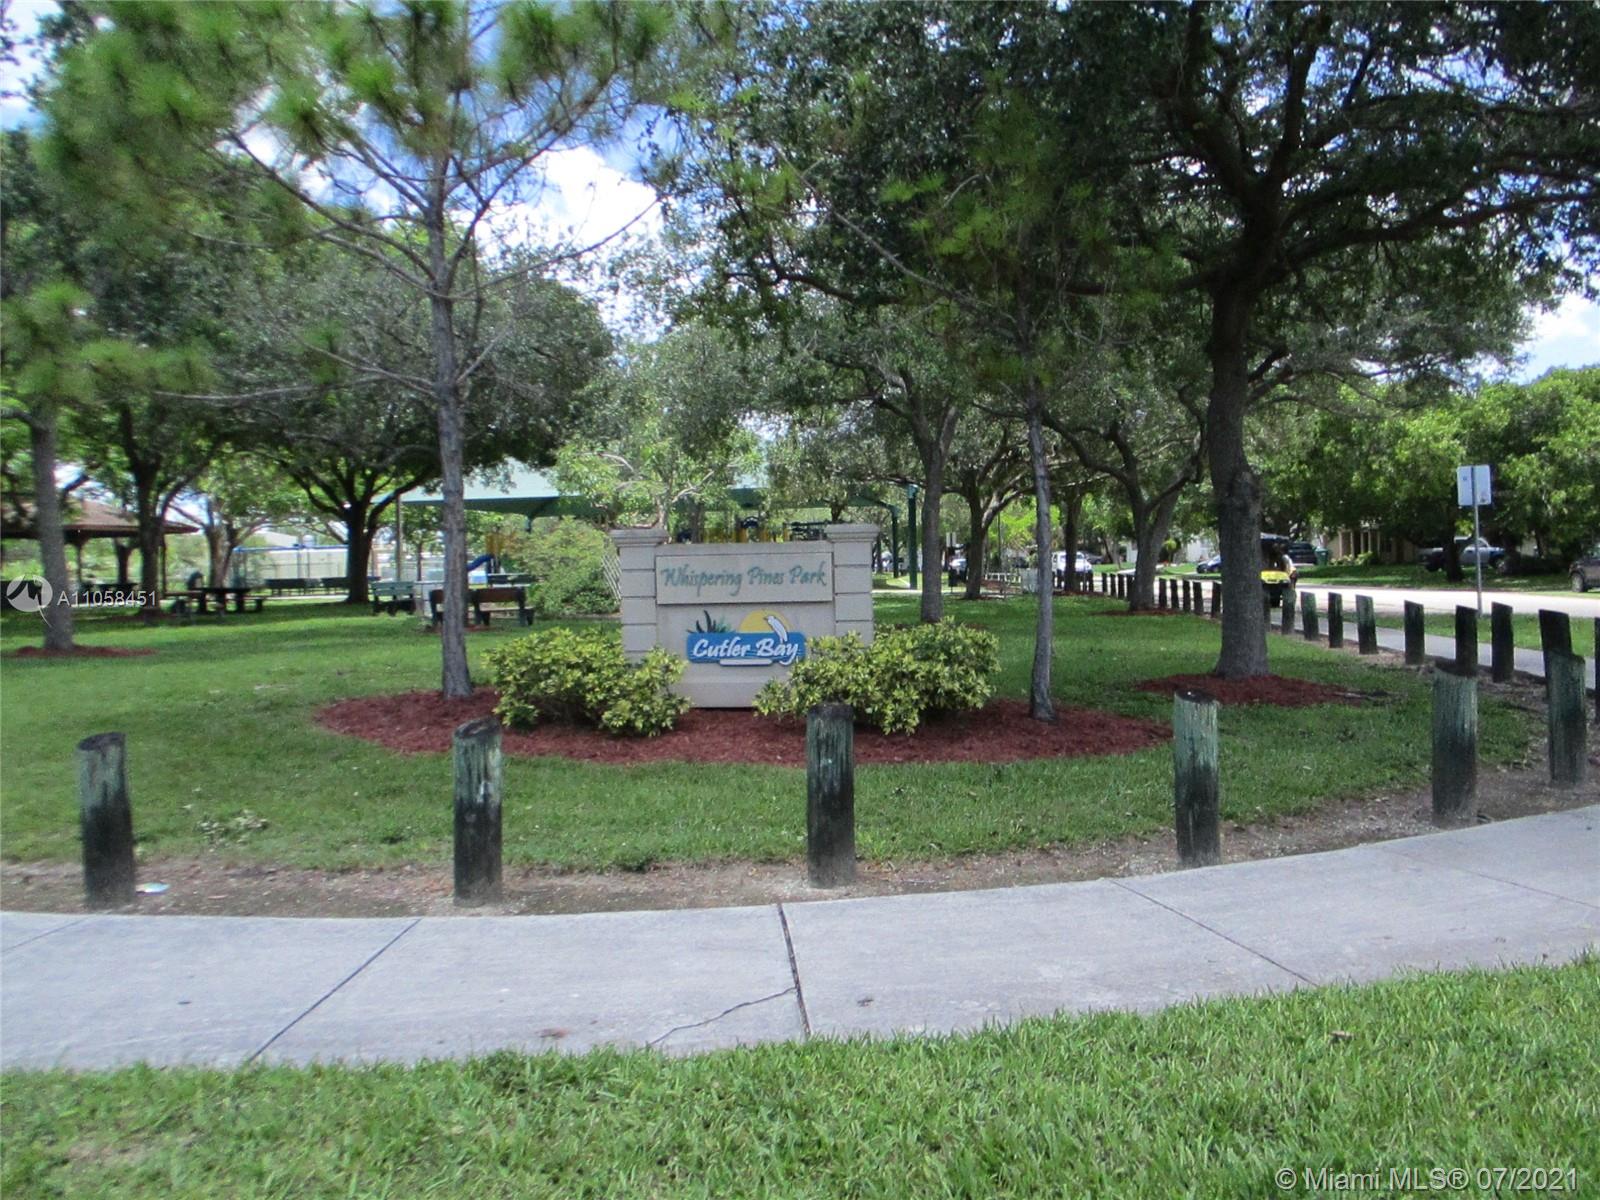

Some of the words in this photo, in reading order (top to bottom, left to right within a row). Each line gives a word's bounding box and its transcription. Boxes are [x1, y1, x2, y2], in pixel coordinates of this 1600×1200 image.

[661, 564, 742, 596] Whispering
[747, 566, 784, 586] Pines
[789, 561, 827, 587] Park
[693, 636, 751, 658] Cutler
[756, 638, 799, 666] Bay
